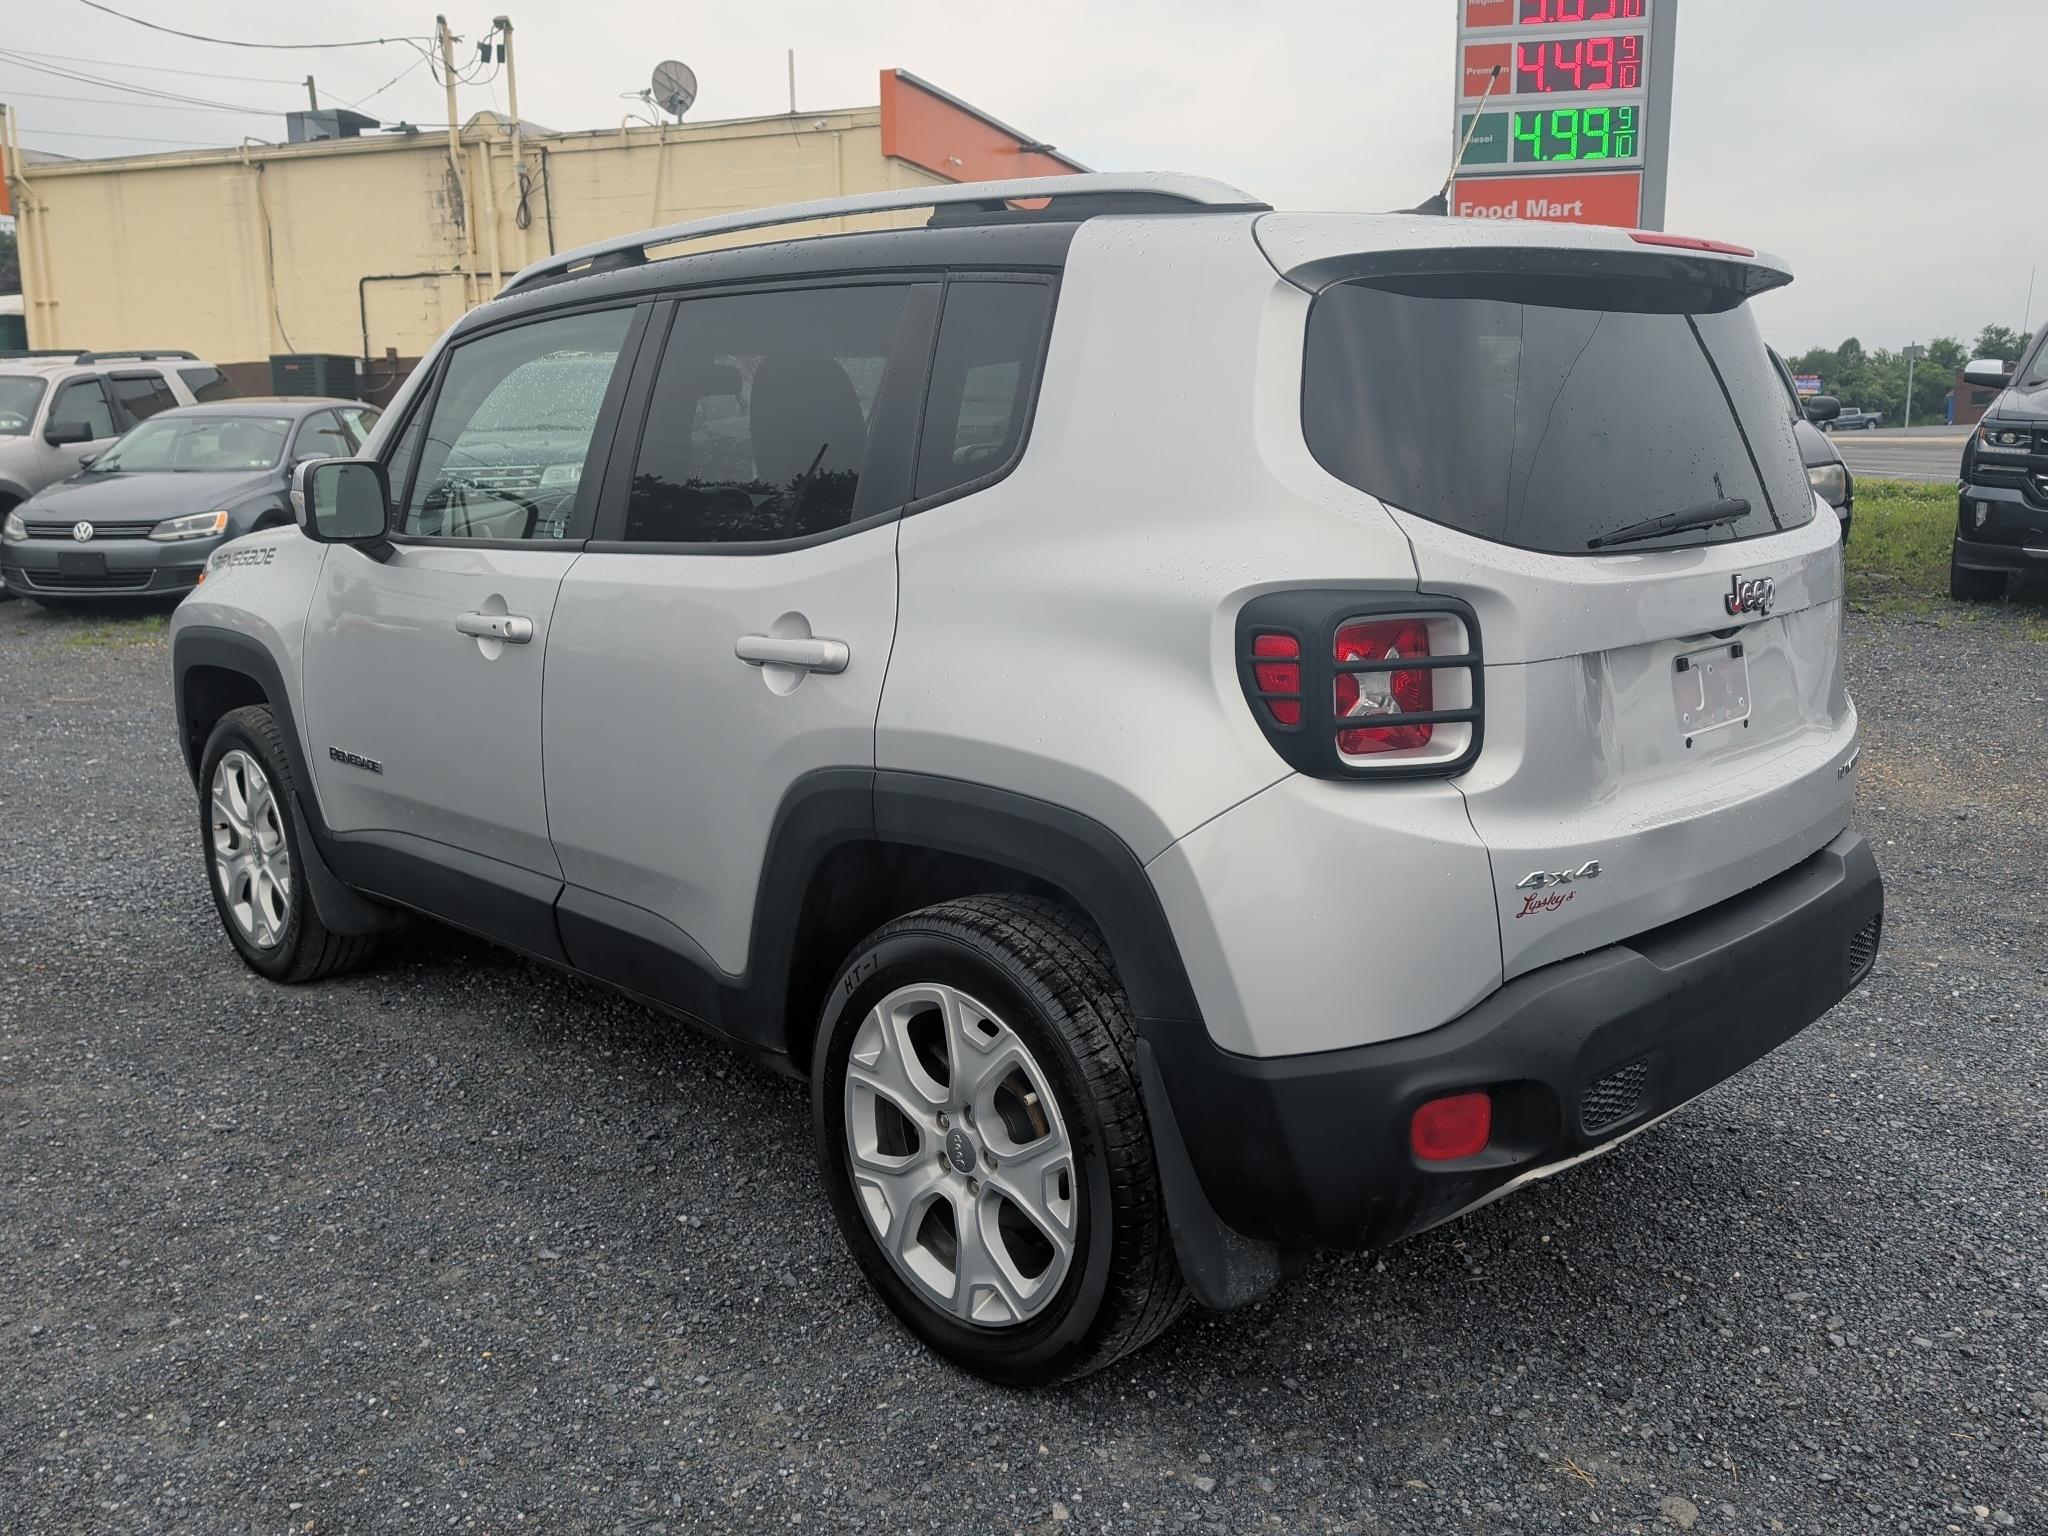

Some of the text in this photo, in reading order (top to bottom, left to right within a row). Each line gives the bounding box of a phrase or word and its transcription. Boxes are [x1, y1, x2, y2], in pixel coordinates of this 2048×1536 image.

[1466, 65, 1509, 76] Premim
[1517, 37, 1614, 92] 4.49
[1513, 107, 1610, 161] 4.99
[1460, 199, 1583, 219] Food Mart
[1725, 573, 1776, 616] Jeep
[1515, 860, 1603, 890] 4x4
[844, 952, 878, 995] HT-1
